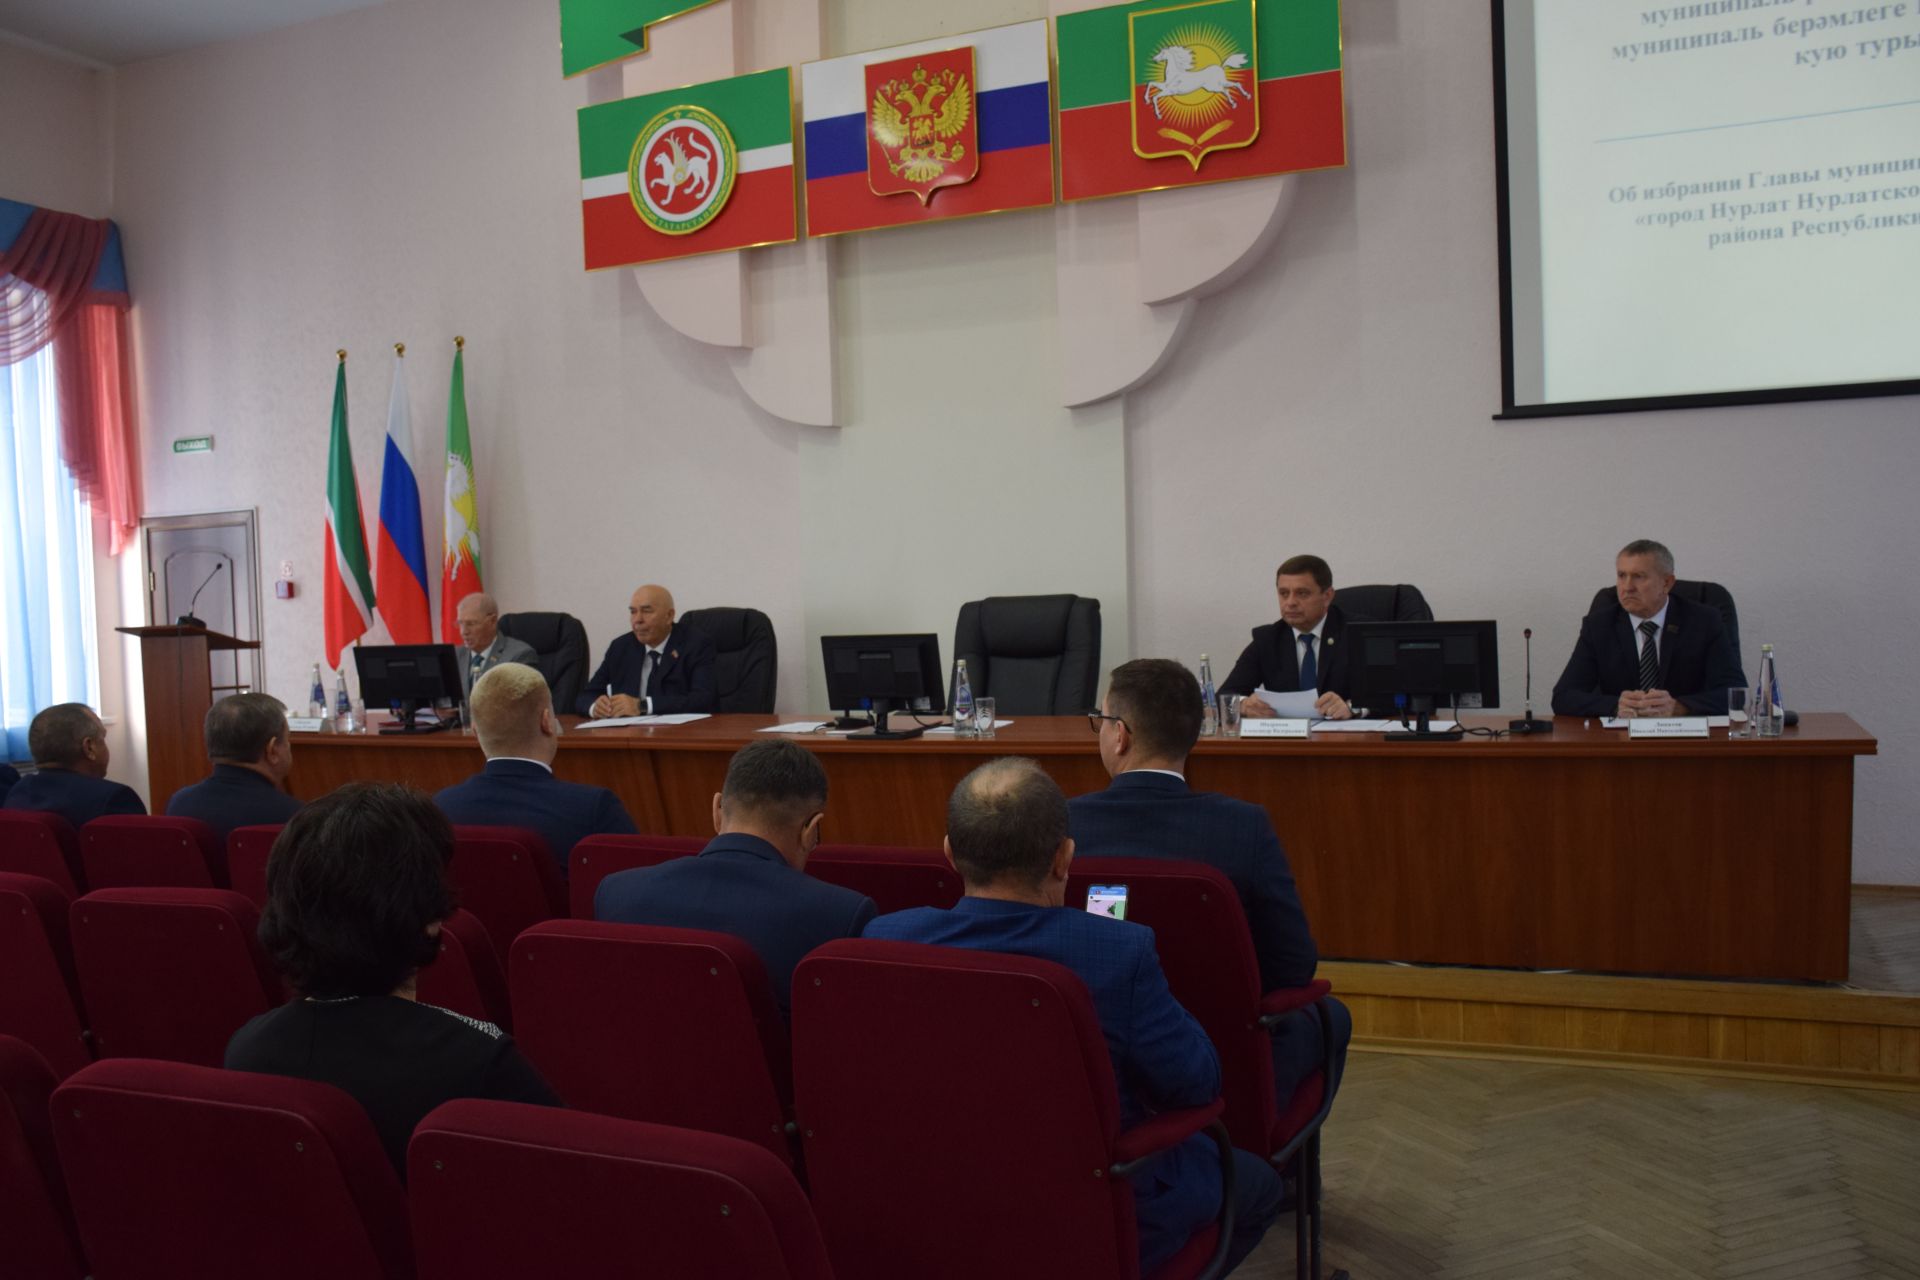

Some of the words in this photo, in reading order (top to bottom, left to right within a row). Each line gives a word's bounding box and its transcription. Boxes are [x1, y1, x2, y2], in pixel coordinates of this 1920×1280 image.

[1611, 25, 1764, 62] муниципаль
[1773, 2, 1907, 37] берәмлеге
[1795, 45, 1847, 67] кую
[1608, 185, 1637, 204] Об
[1643, 173, 1742, 201] избрании
[1748, 167, 1820, 190] Главы
[1710, 197, 1791, 222] Нурлат
[1797, 185, 1920, 212] Нурлатско
[1708, 225, 1784, 250] района
